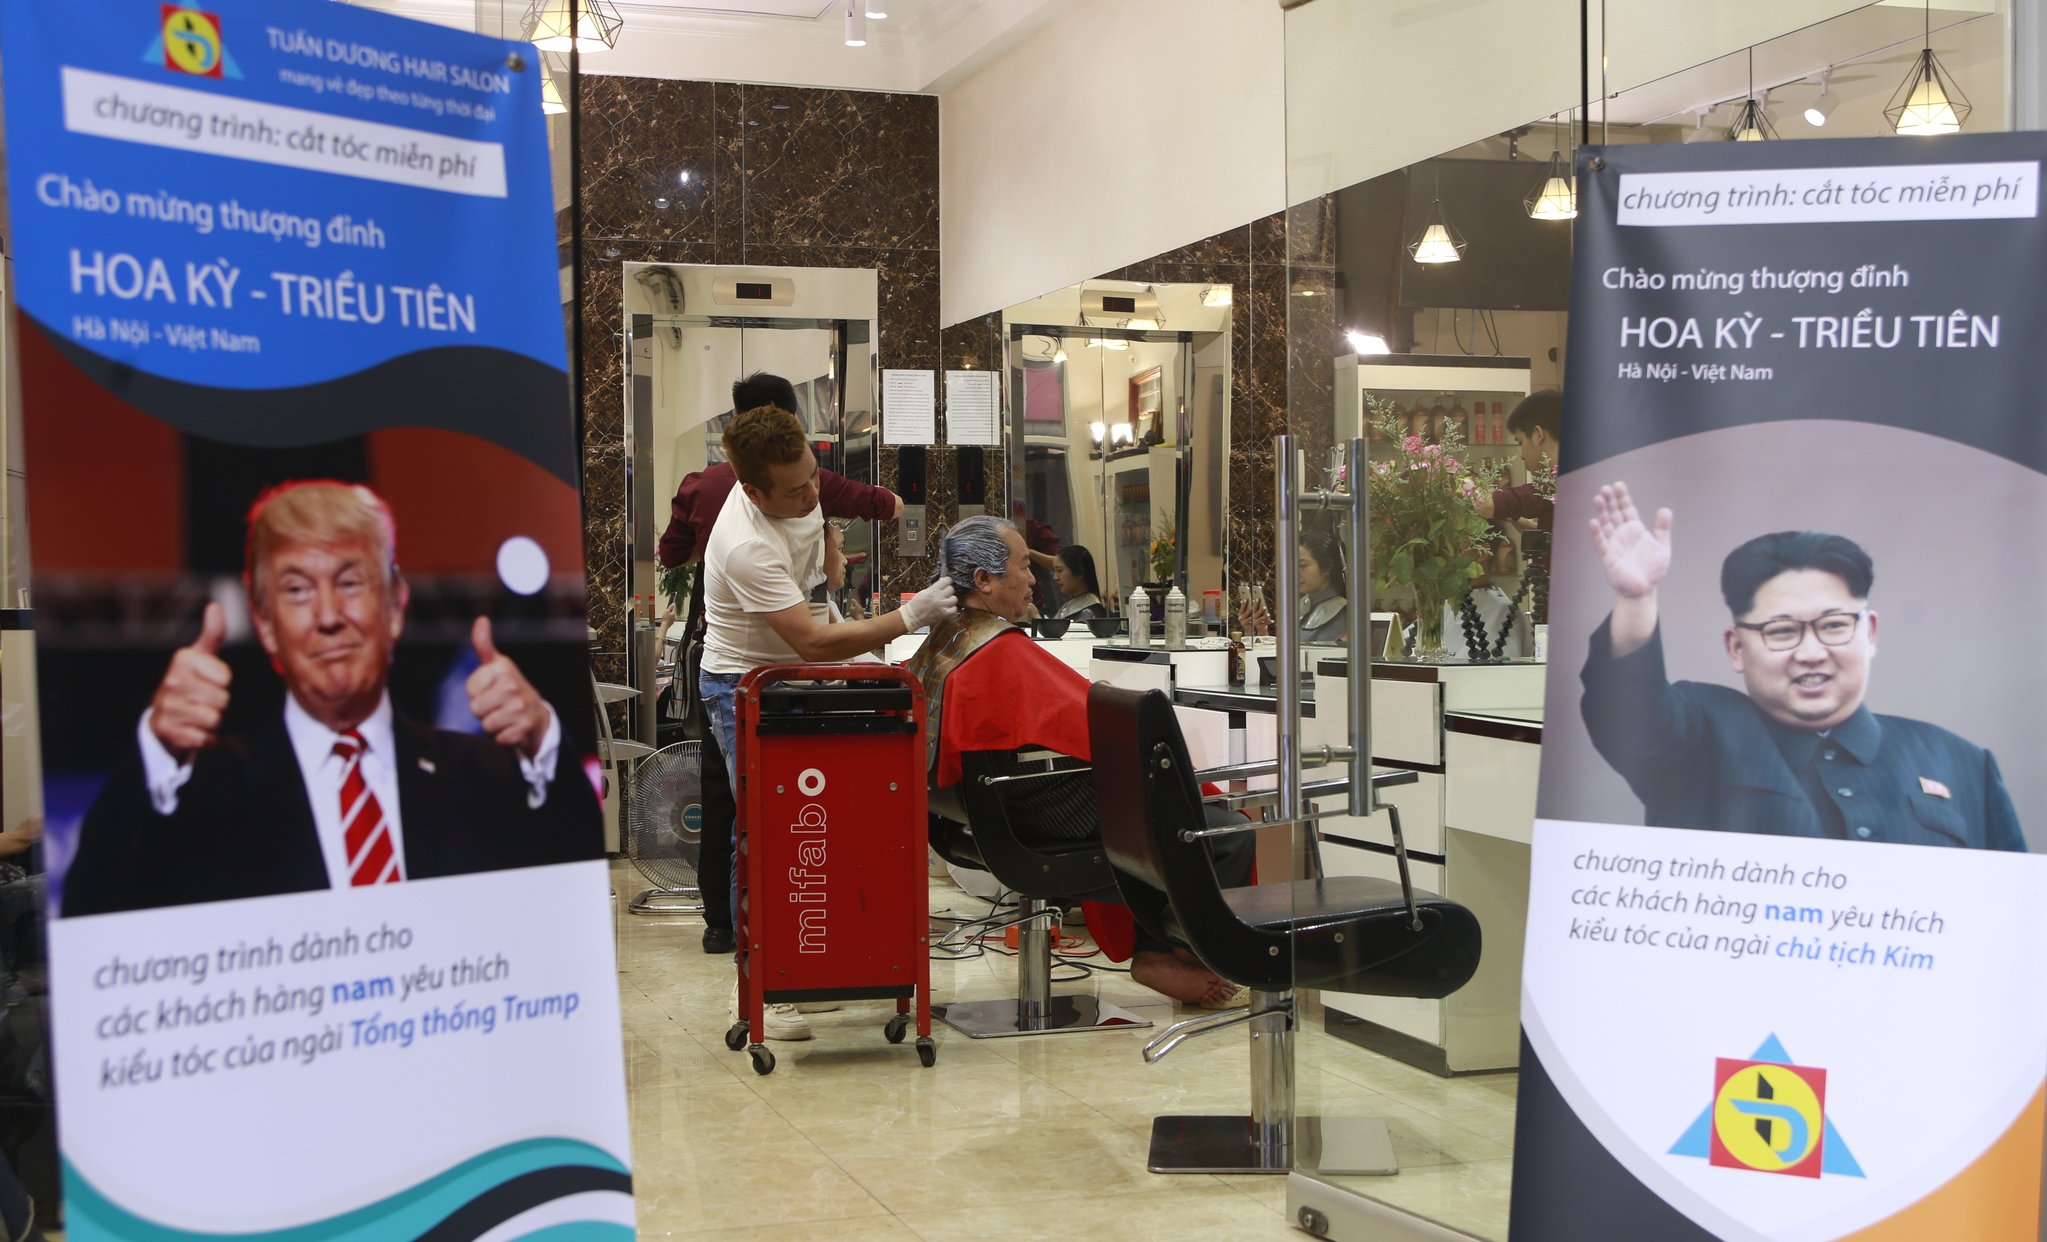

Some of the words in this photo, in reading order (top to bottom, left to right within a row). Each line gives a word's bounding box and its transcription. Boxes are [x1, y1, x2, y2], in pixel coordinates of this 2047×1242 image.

[403, 56, 448, 82] HAIR
[450, 67, 510, 94] SALON
[95, 93, 203, 139] chương
[210, 112, 281, 147] trình:
[287, 126, 325, 154] cắt
[333, 135, 370, 161] tóc
[439, 154, 476, 180] phí
[37, 173, 121, 215] Chào
[126, 188, 214, 235] mừng
[219, 199, 322, 248] thượng
[1624, 186, 1721, 215] chương
[1727, 182, 1797, 209] trình:
[1803, 179, 1844, 206] cắt
[1851, 181, 1892, 205] tóc
[1898, 175, 1966, 204] miễn
[1972, 175, 2023, 208] phí
[69, 248, 176, 304] HOA
[186, 256, 241, 310] KỲ
[251, 290, 267, 299] -
[270, 269, 386, 325] TRIỀU
[390, 283, 477, 334] TIÊN
[1602, 266, 1666, 290] Chào
[1671, 268, 1745, 296] mừng
[1750, 266, 1844, 294] thượng
[1850, 264, 1909, 288] đỉnh
[73, 316, 107, 341] Hà
[109, 318, 150, 348] Nội
[164, 323, 208, 353] Việt
[209, 328, 261, 354] Nam
[1620, 316, 1704, 349] HOA
[1714, 311, 1763, 349] KỲ
[1791, 307, 1902, 349] TRIỀU
[1910, 308, 2000, 349] TIÊN
[1617, 362, 1642, 379] Hà
[1646, 363, 1678, 383] Nội
[1691, 364, 1727, 384] Việt
[1730, 364, 1773, 380] Nam
[788, 767, 827, 954] mifabo
[1573, 849, 1662, 881] chương
[1669, 857, 1725, 880] trình
[1732, 860, 1795, 886] dành
[1801, 866, 1847, 890] cho
[1571, 884, 1611, 907] các
[1616, 886, 1688, 913] khách
[1694, 893, 1758, 924] hàng
[1764, 904, 1823, 924] nam
[1828, 905, 1874, 931] yêu
[1881, 908, 1944, 934] thích
[93, 955, 209, 990] chương
[216, 941, 283, 974] trình
[289, 932, 359, 963] dành
[365, 923, 413, 953] cho
[1569, 917, 1617, 943] kiểu
[1624, 924, 1660, 946] tóc
[1665, 927, 1708, 950] của
[1714, 934, 1770, 960] ngài
[1776, 936, 1821, 960] chủ
[1829, 941, 1876, 968] tịch
[1883, 945, 1935, 970] Kim
[97, 1005, 149, 1040] các
[155, 990, 245, 1031] khách
[252, 984, 325, 1017] hàng
[332, 976, 394, 1005] nam
[400, 964, 444, 1003] yêu
[450, 952, 510, 987] thích
[172, 1044, 218, 1077] tóc
[223, 1034, 275, 1070] của
[281, 1023, 343, 1065] ngài
[421, 999, 496, 1035] thống
[502, 991, 580, 1022] Trump
